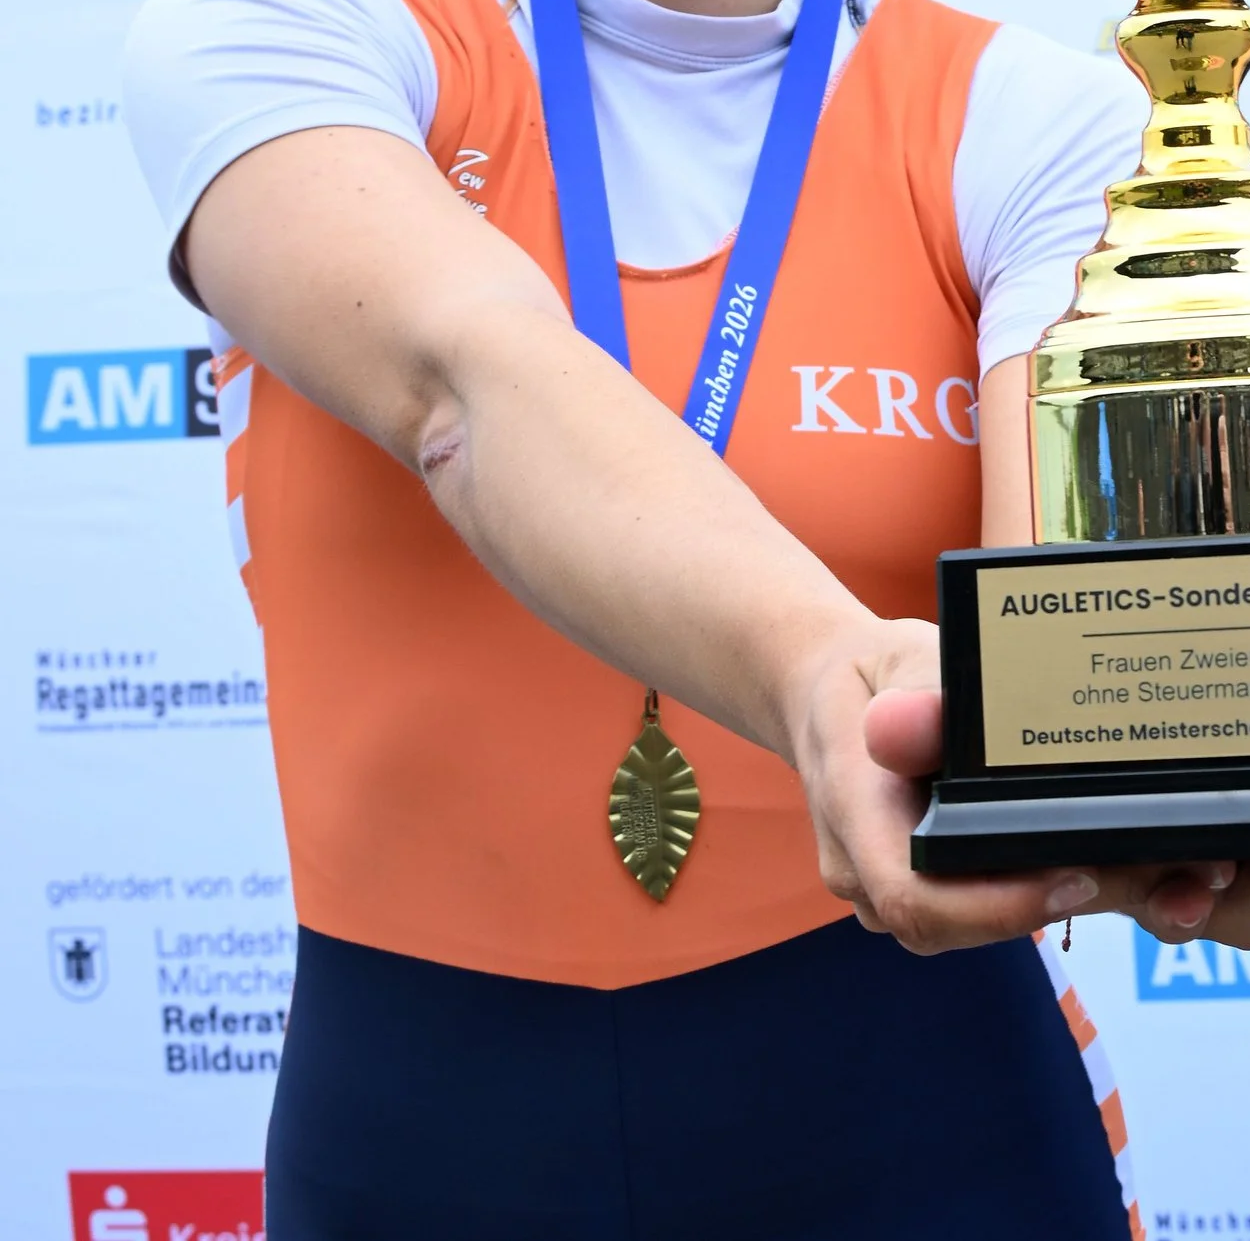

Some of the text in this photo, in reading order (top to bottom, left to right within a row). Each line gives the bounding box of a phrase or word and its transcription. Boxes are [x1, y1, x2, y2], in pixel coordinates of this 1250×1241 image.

[720, 283, 758, 348] 2026
[40, 363, 173, 432] AM
[790, 365, 980, 446] KRG
[1091, 652, 1172, 674] Frauen
[36, 677, 265, 720] Regattagemein
[1072, 684, 1130, 705] ohne
[1022, 724, 1124, 746] Deutsche
[183, 875, 233, 898] von
[241, 870, 287, 897] der
